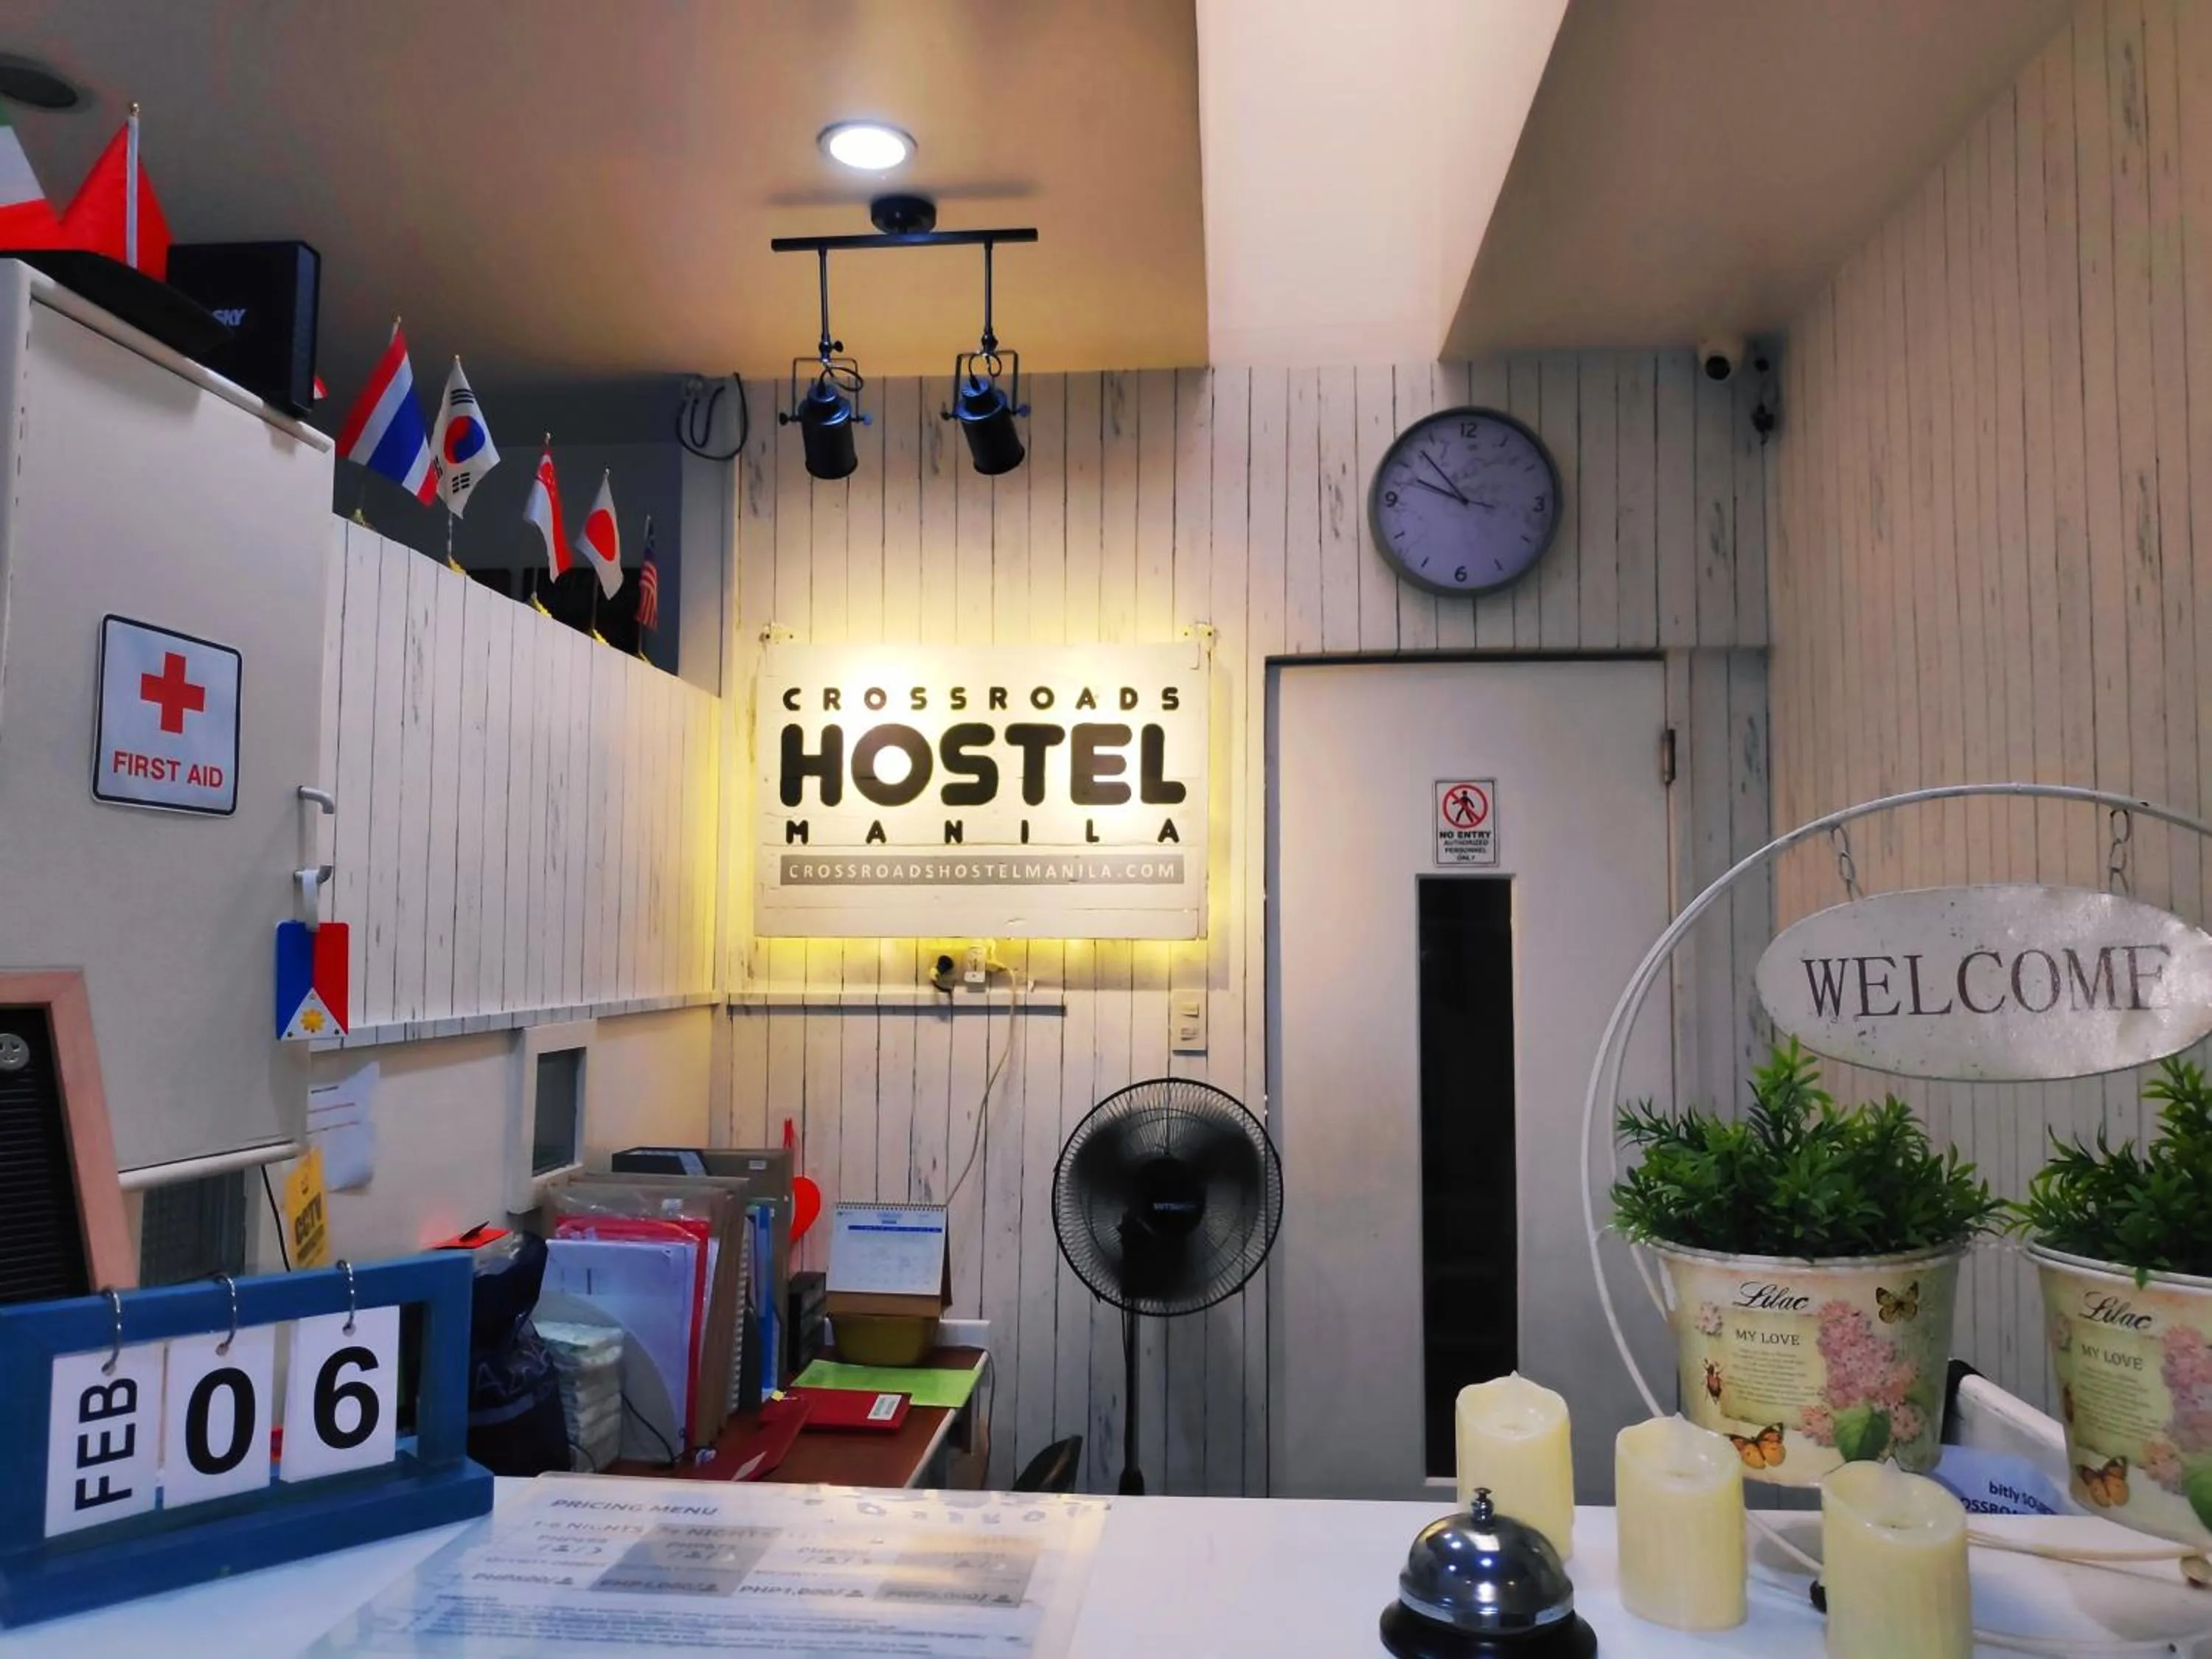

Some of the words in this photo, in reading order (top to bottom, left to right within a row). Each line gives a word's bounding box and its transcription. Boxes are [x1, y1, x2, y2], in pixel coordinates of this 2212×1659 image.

[1460, 422, 1478, 438] 12
[1385, 490, 1398, 507] 9
[1532, 496, 1545, 512] 3
[1454, 566, 1468, 582] 6
[782, 686, 1180, 711] CROSSROADS
[113, 750, 181, 782] FIRST
[187, 763, 223, 788] AID
[780, 723, 1186, 807] HOSTEL
[785, 818, 1180, 845] MANILA
[1439, 831, 1454, 839] NO
[1457, 831, 1491, 839] ENTRY
[789, 863, 1175, 879] CROSSROADSHOSTELMANILA.COM
[1801, 944, 2172, 1019] WELCOME
[295, 1192, 322, 1246] CCTV
[1731, 1281, 1810, 1311] Lilac
[2079, 1290, 2153, 1329] Lilac
[1736, 1329, 1757, 1341] MY
[1761, 1332, 1801, 1346] LOVE
[2081, 1343, 2100, 1363] MY
[2104, 1351, 2143, 1371] LOVE
[74, 1376, 138, 1511] FEB
[549, 1498, 642, 1514] PRICING
[650, 1503, 720, 1517] MENU
